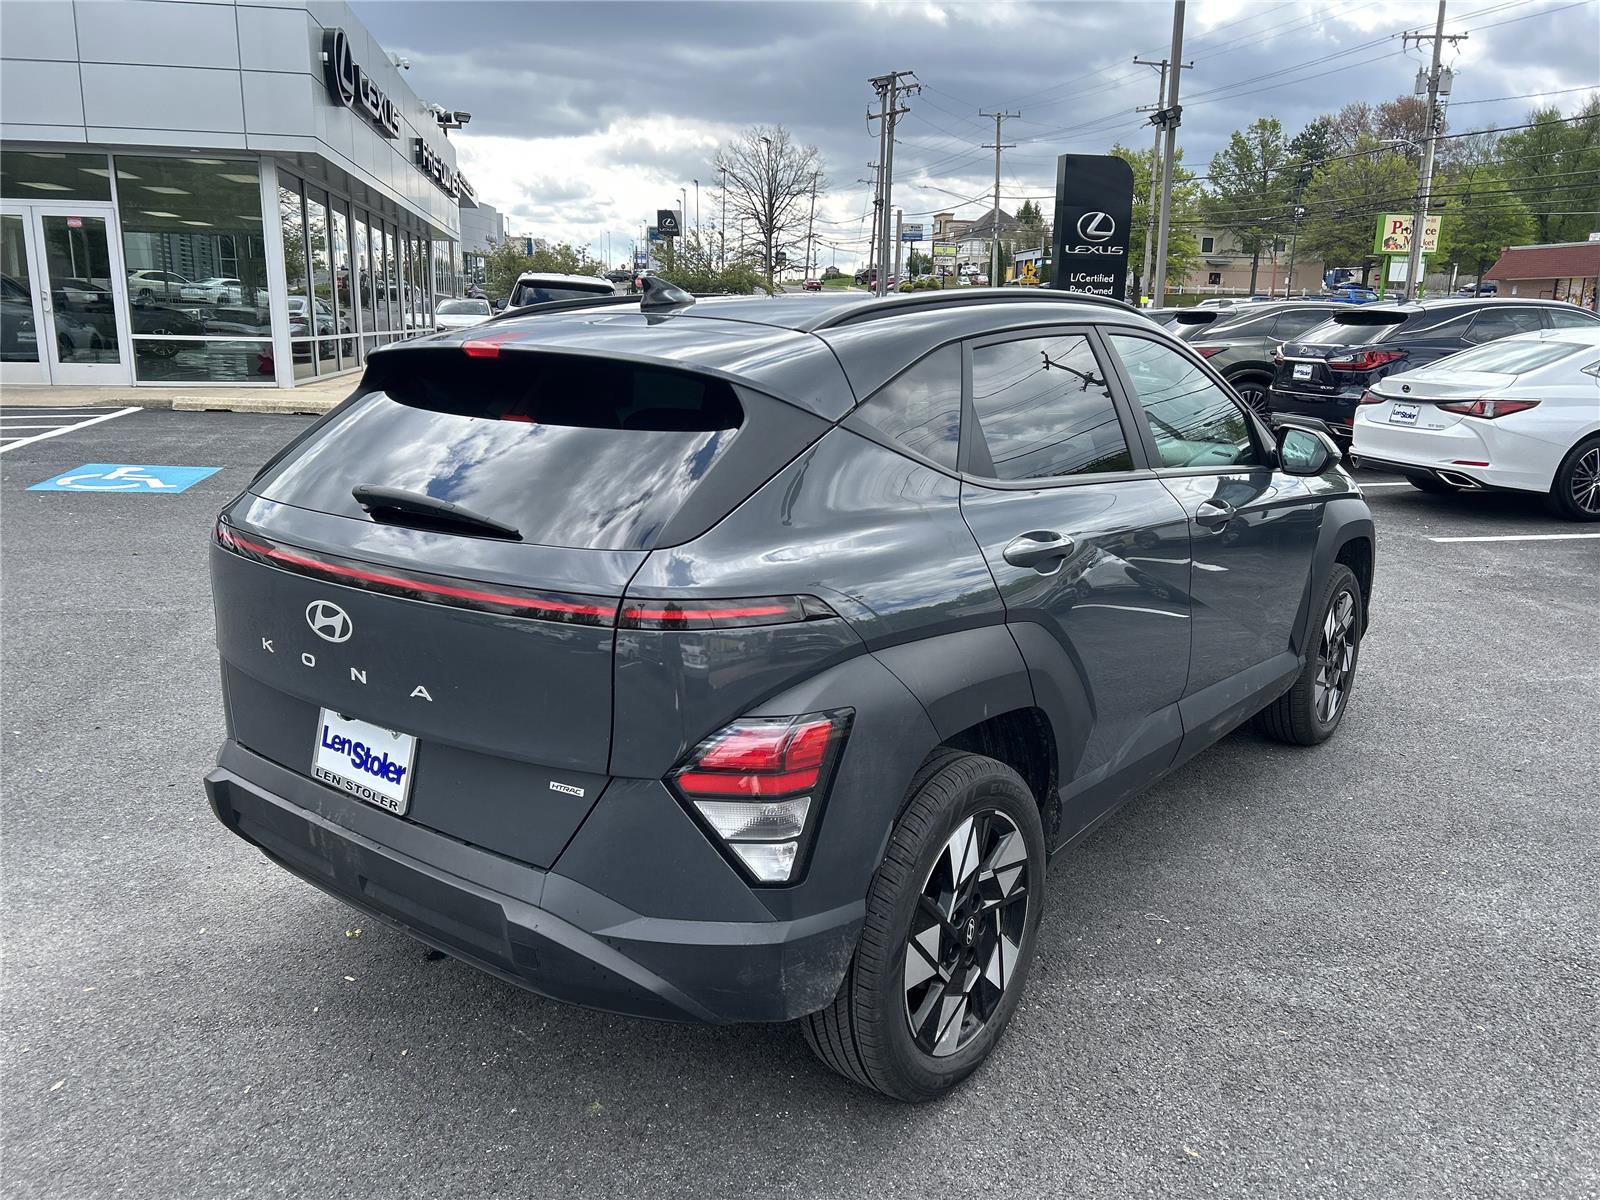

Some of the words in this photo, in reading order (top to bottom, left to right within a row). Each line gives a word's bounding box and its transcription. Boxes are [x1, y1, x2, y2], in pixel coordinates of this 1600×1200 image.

[356, 66, 400, 139] LEXUS
[1391, 220, 1437, 235] Proce
[1065, 244, 1124, 255] LEXUS
[1070, 272, 1115, 283] L/Certified
[1069, 285, 1114, 295] Pre-Owned
[315, 767, 342, 786] LEN
[345, 780, 399, 812] STOLER
[551, 783, 582, 796] HTRAC
